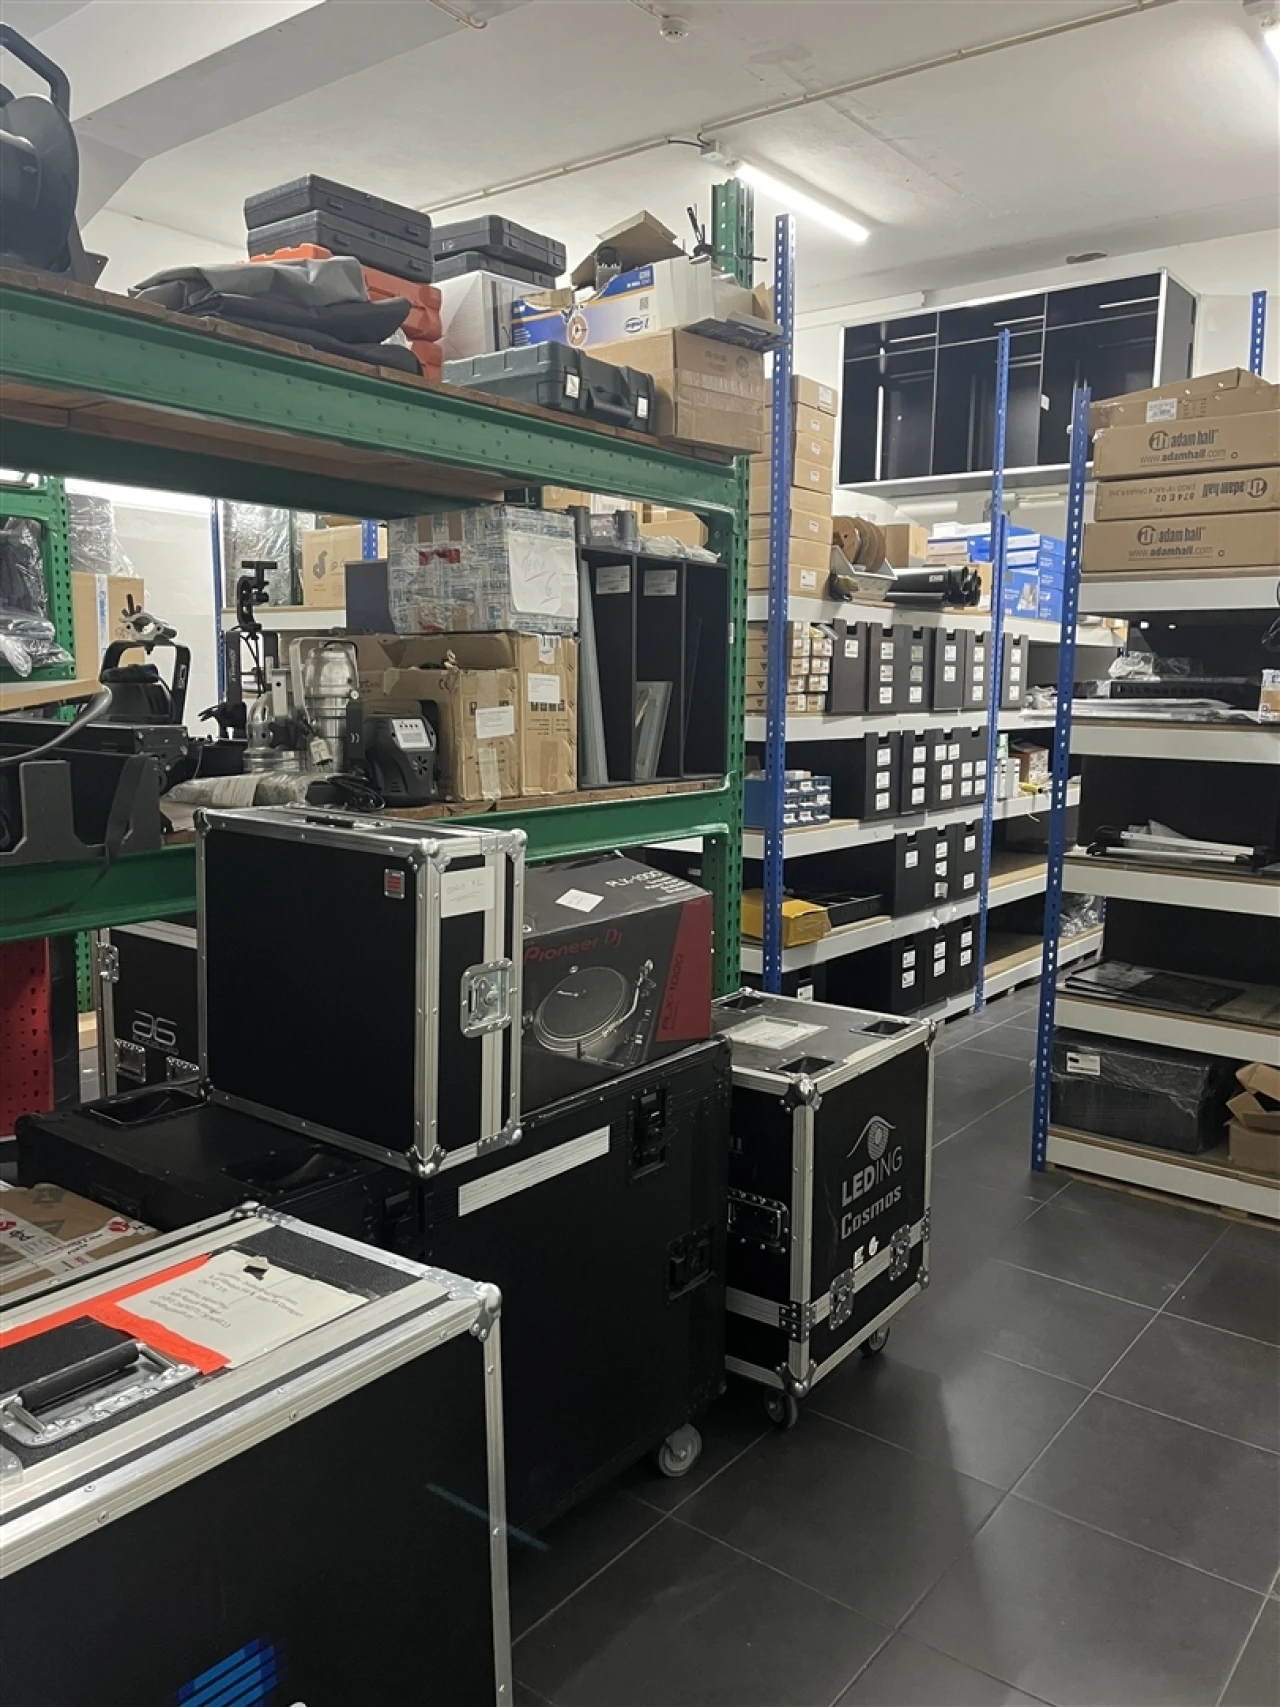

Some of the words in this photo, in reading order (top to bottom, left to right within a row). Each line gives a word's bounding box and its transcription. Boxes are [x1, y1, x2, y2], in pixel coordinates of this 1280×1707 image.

[1170, 432, 1197, 447] adam
[1198, 429, 1216, 445] hall
[1139, 448, 1227, 463] www.adamhall.com
[1202, 482, 1220, 499] hall
[1220, 480, 1246, 496] adam
[1157, 527, 1183, 544] adam
[1184, 526, 1204, 541] hall
[1128, 546, 1213, 558] www.adamhall.com
[523, 936, 600, 964] Pioneer
[841, 1145, 903, 1208] LEDING
[841, 1185, 902, 1240] Cosmos
